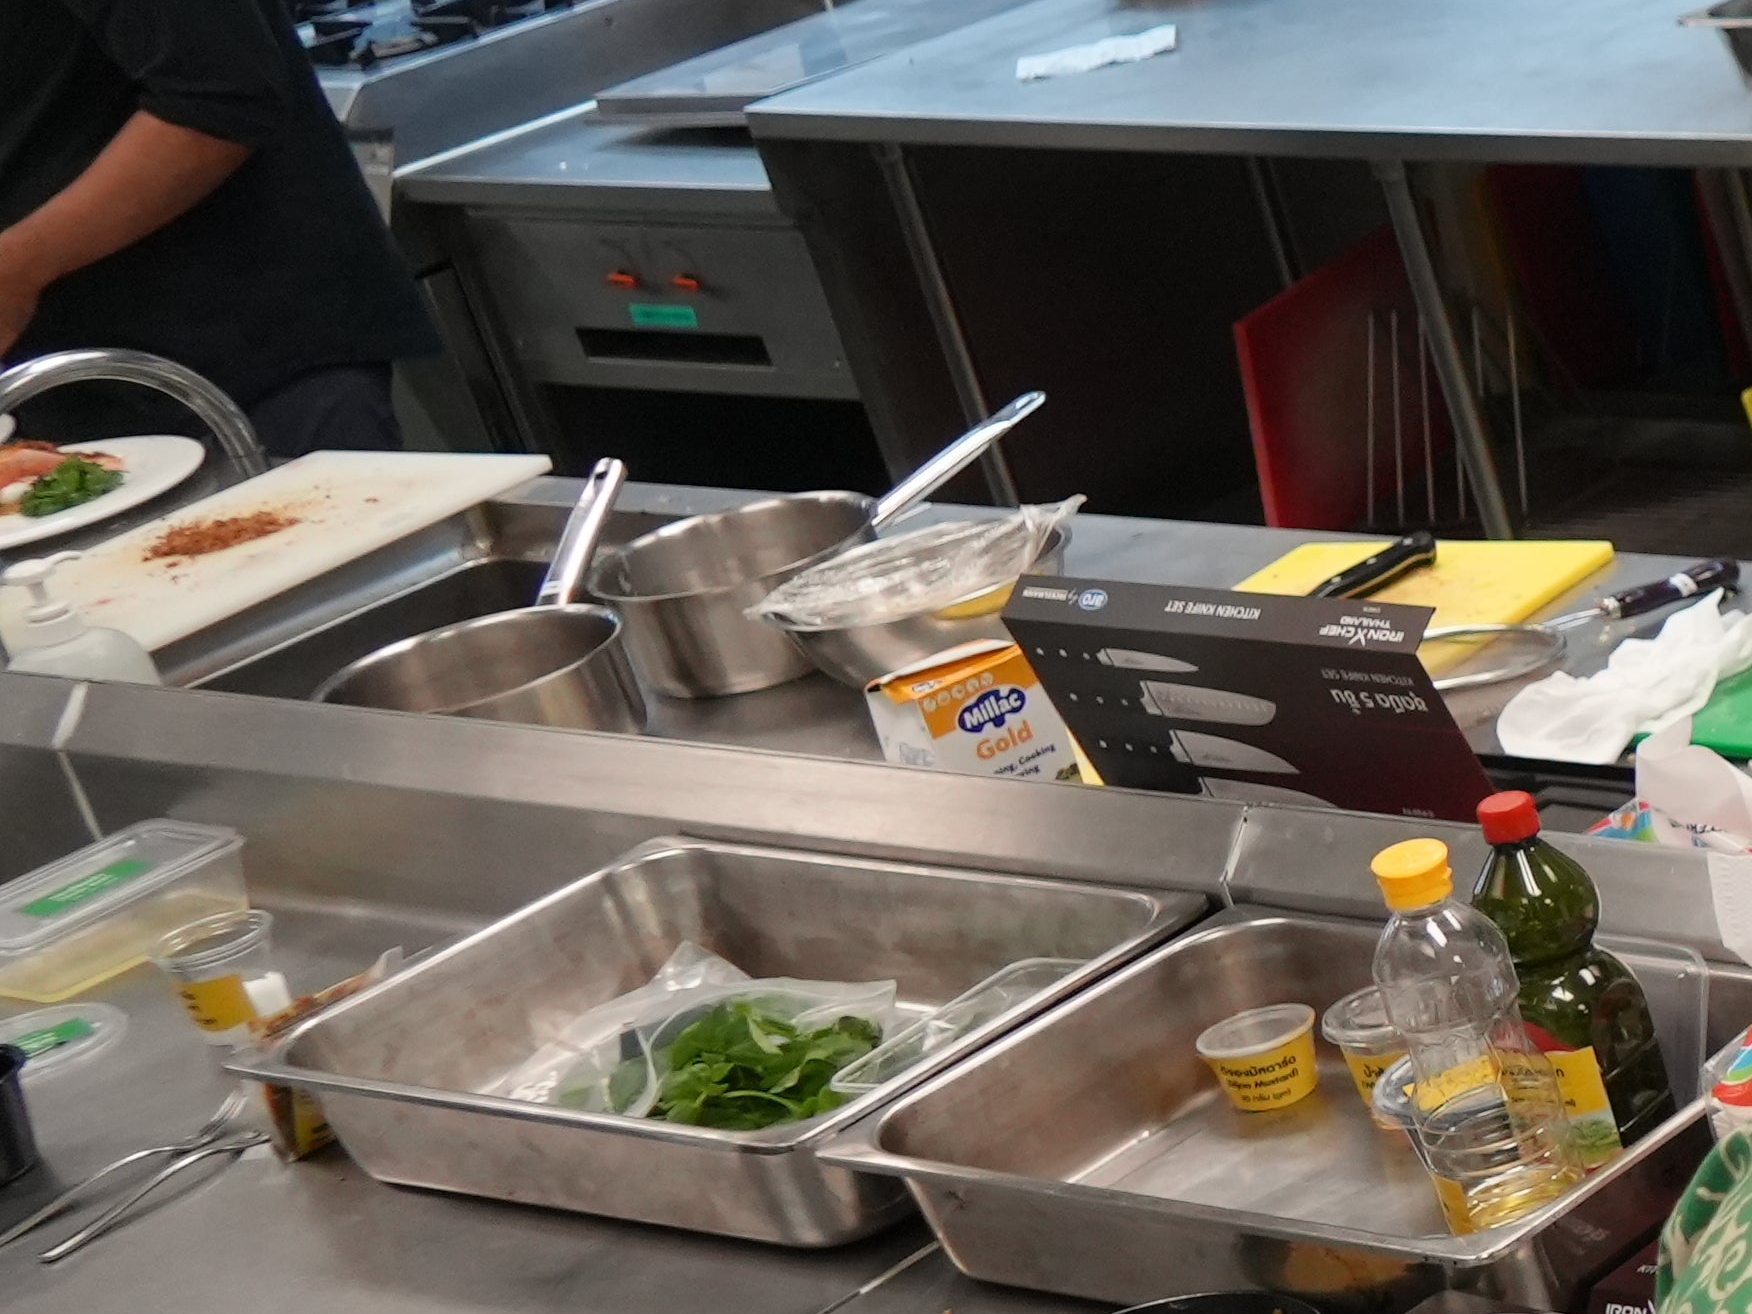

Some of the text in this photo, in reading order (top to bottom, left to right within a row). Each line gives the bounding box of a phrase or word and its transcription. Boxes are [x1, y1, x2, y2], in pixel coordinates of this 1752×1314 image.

[1164, 600, 1262, 621] KITCHEN KNIFE SET
[1340, 615, 1391, 628] THAILAND
[1321, 668, 1340, 680] SET
[1370, 673, 1415, 686] KITCHEN
[1360, 691, 1375, 709] 5
[963, 691, 1022, 730] Millac
[976, 720, 1033, 760] Gold
[1019, 744, 1056, 765] Cooking
